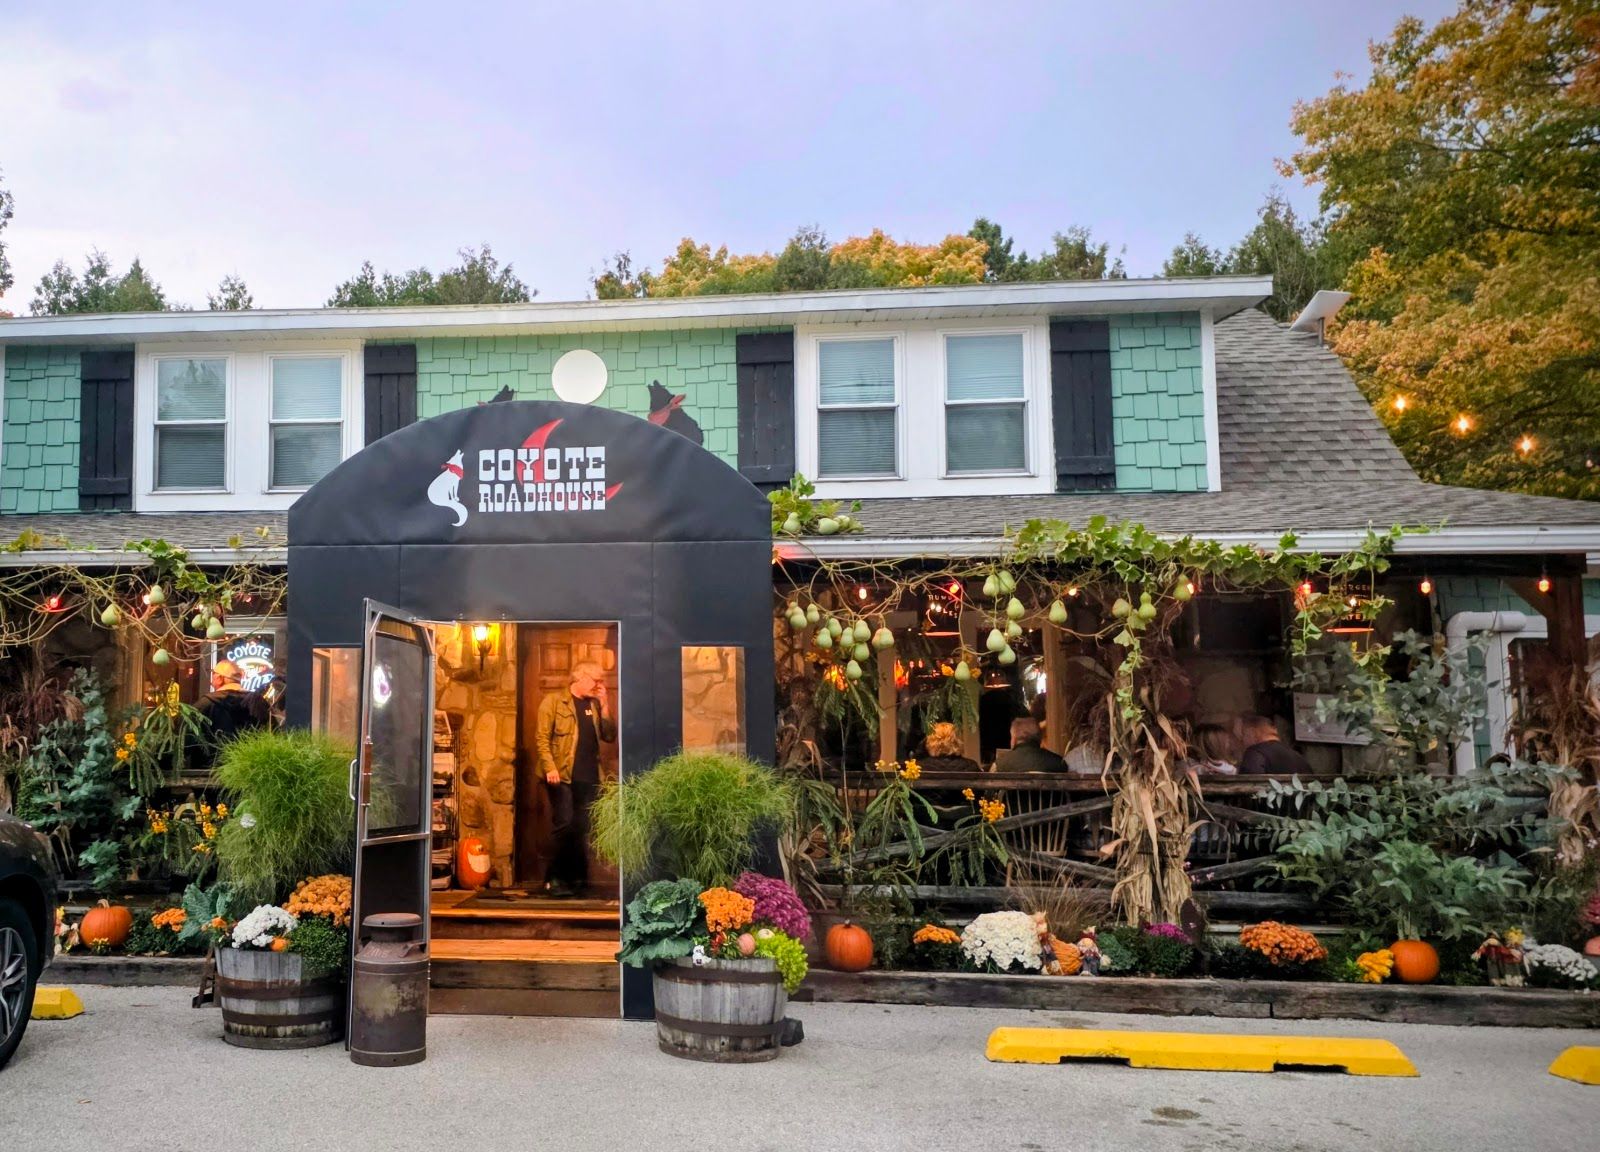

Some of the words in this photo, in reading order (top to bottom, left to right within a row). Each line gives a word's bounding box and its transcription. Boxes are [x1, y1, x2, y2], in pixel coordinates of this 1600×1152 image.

[478, 446, 606, 481] COYOTE
[478, 481, 606, 513] ROADHOUSE
[226, 642, 272, 662] COYOTE
